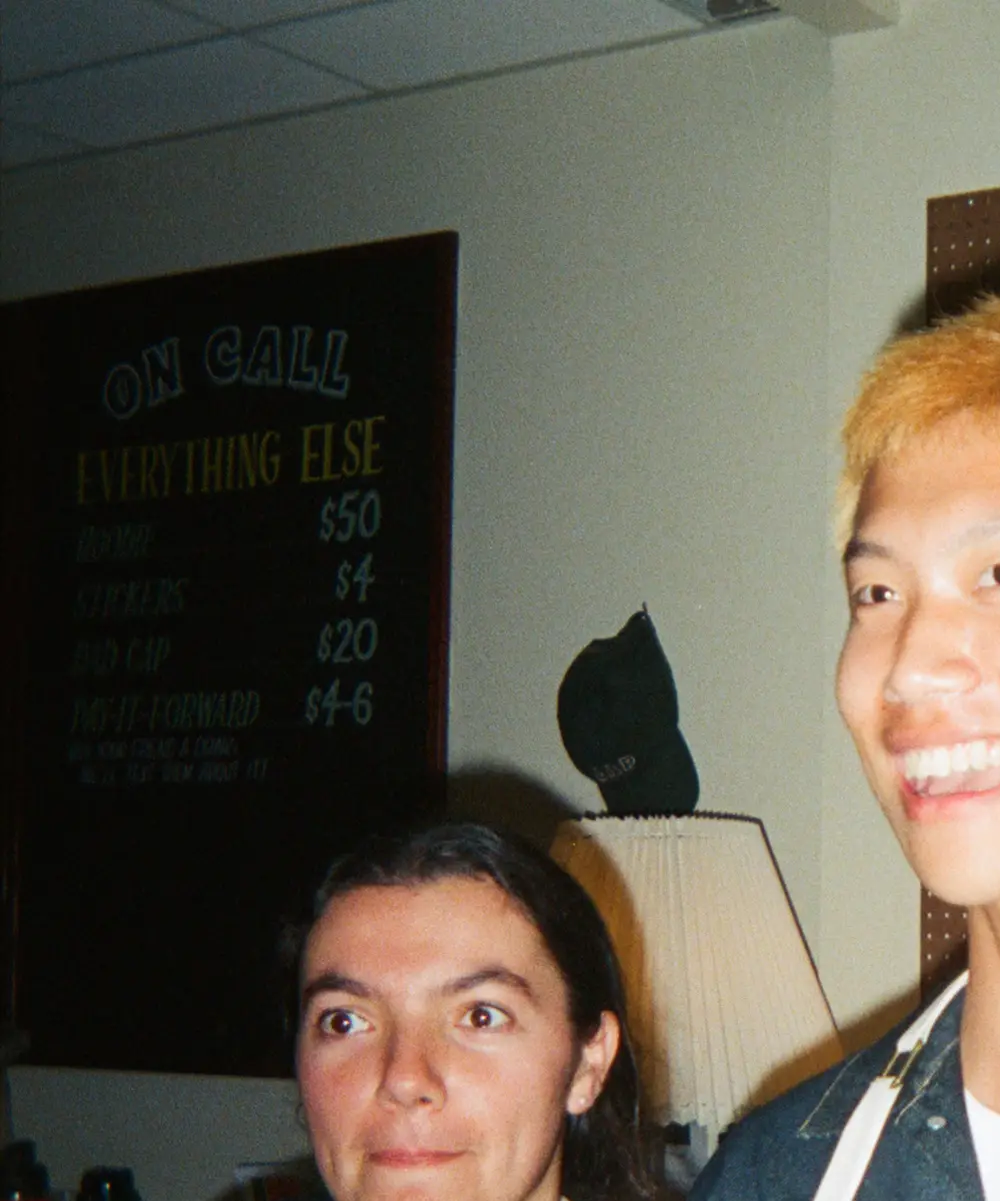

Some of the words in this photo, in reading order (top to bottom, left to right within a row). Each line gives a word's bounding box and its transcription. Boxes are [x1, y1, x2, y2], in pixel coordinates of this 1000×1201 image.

[102, 337, 185, 420] ON
[205, 324, 350, 399] CALL
[77, 430, 281, 504] EVERYTHING
[300, 415, 385, 484] ELSE
[320, 488, 382, 543] $50
[335, 552, 376, 603] $4
[317, 617, 378, 663] $20
[305, 677, 373, 727] $4-6
